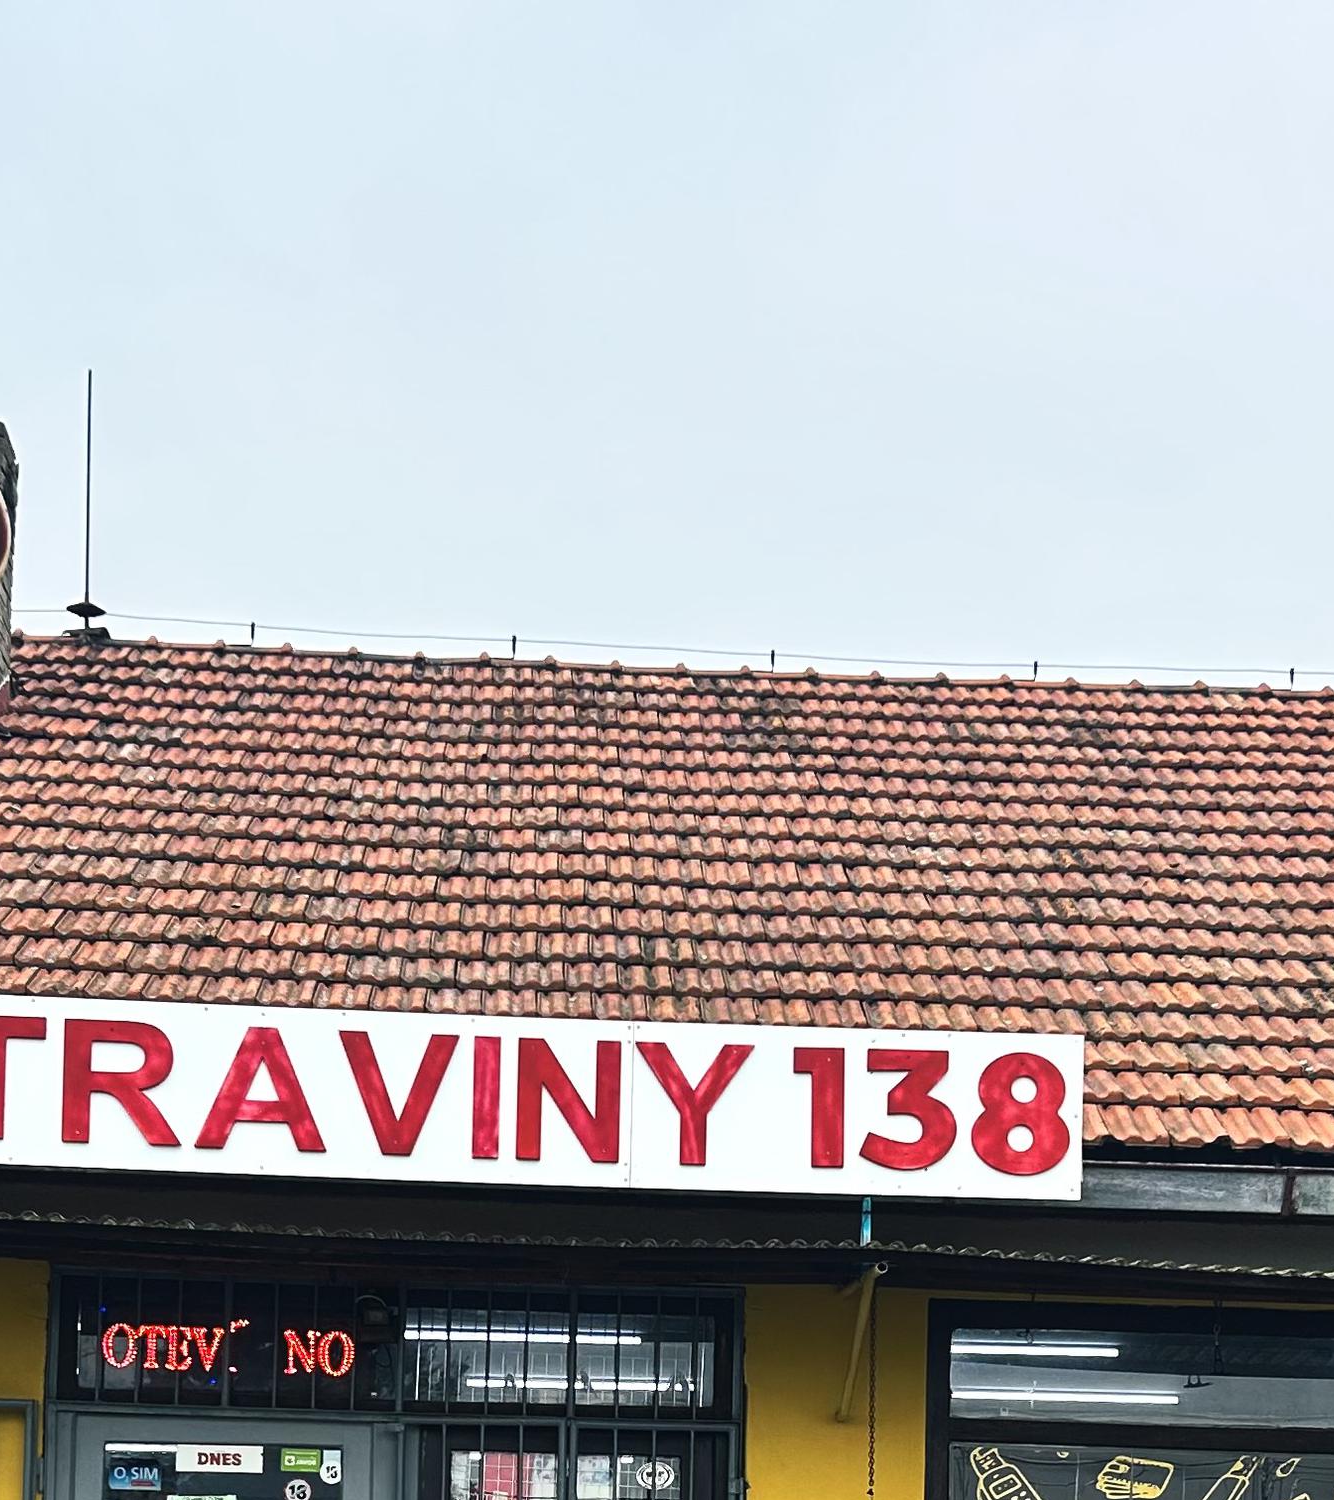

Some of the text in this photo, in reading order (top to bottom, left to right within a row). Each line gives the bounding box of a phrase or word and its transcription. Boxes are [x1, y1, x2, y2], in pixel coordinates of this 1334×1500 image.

[792, 1046, 1071, 1177] 138
[102, 1318, 356, 1377] OTEVNO
[130, 1466, 159, 1481] SIM
[197, 1452, 242, 1466] DNES
